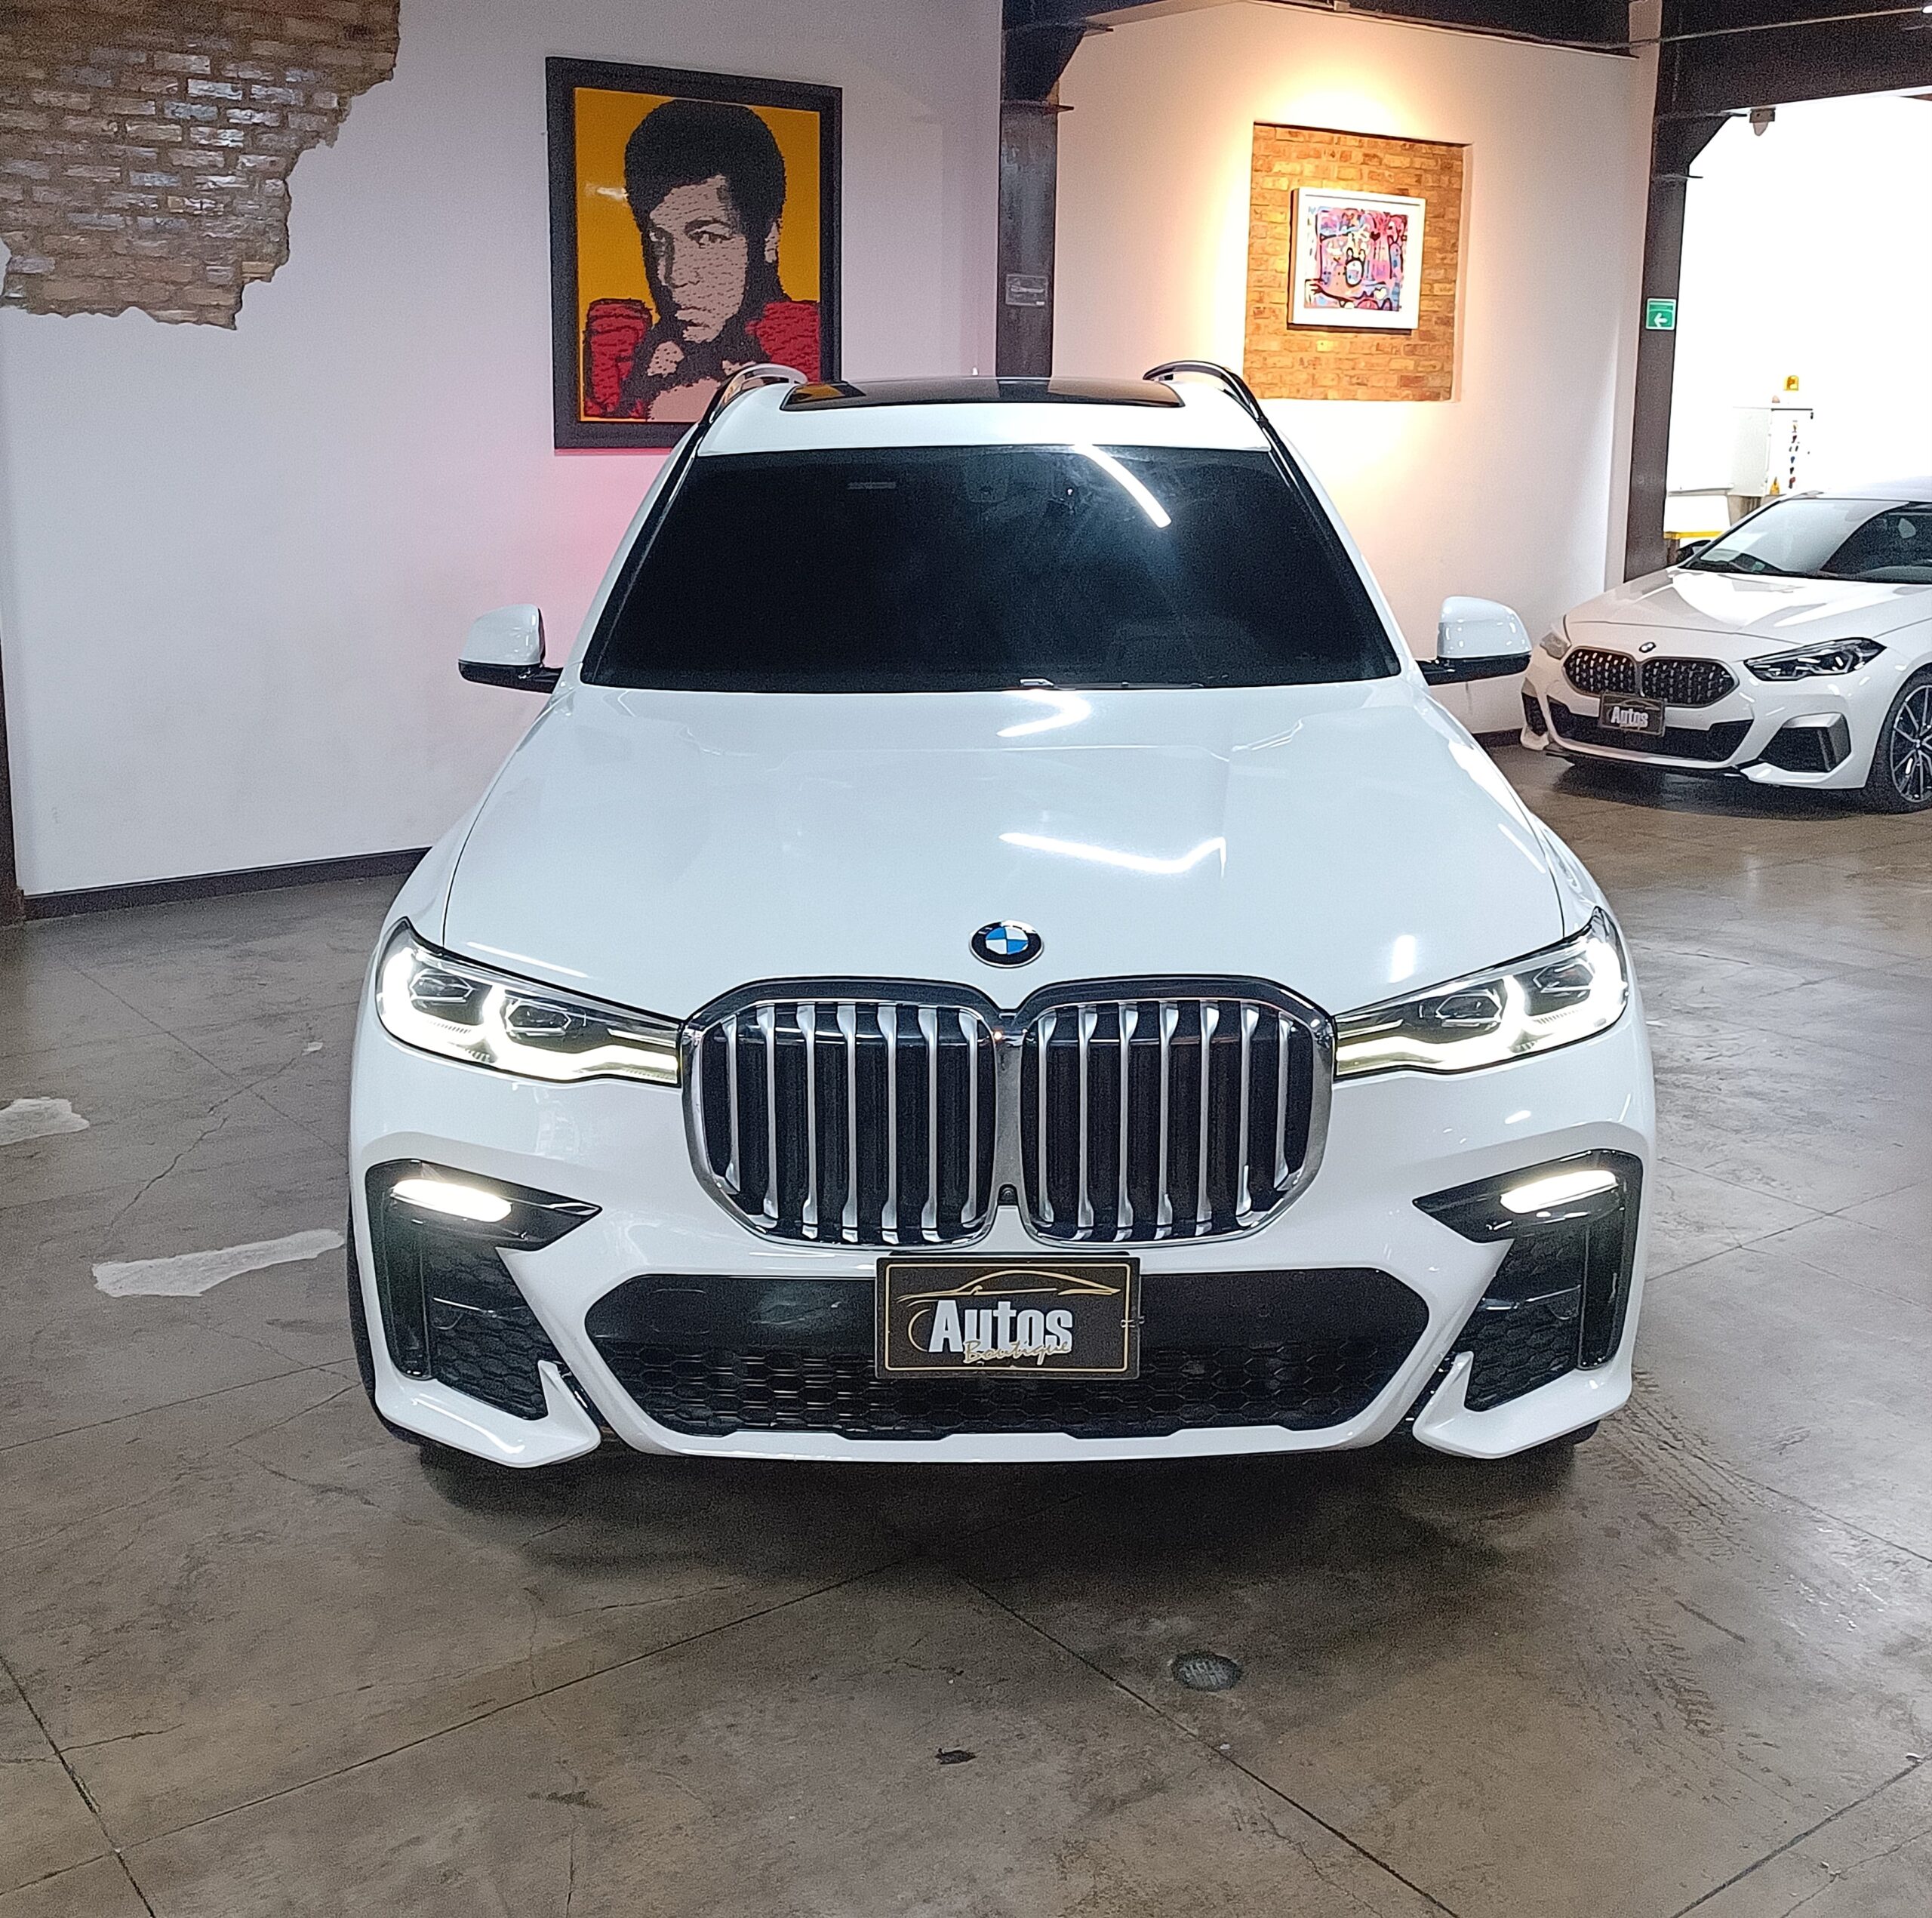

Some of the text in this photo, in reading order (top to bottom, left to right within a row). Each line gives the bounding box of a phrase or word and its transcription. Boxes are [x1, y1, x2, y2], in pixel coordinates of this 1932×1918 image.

[1611, 707, 1648, 727] Autos
[928, 1300, 1073, 1353] Autos
[963, 1339, 1070, 1365] Boutique
